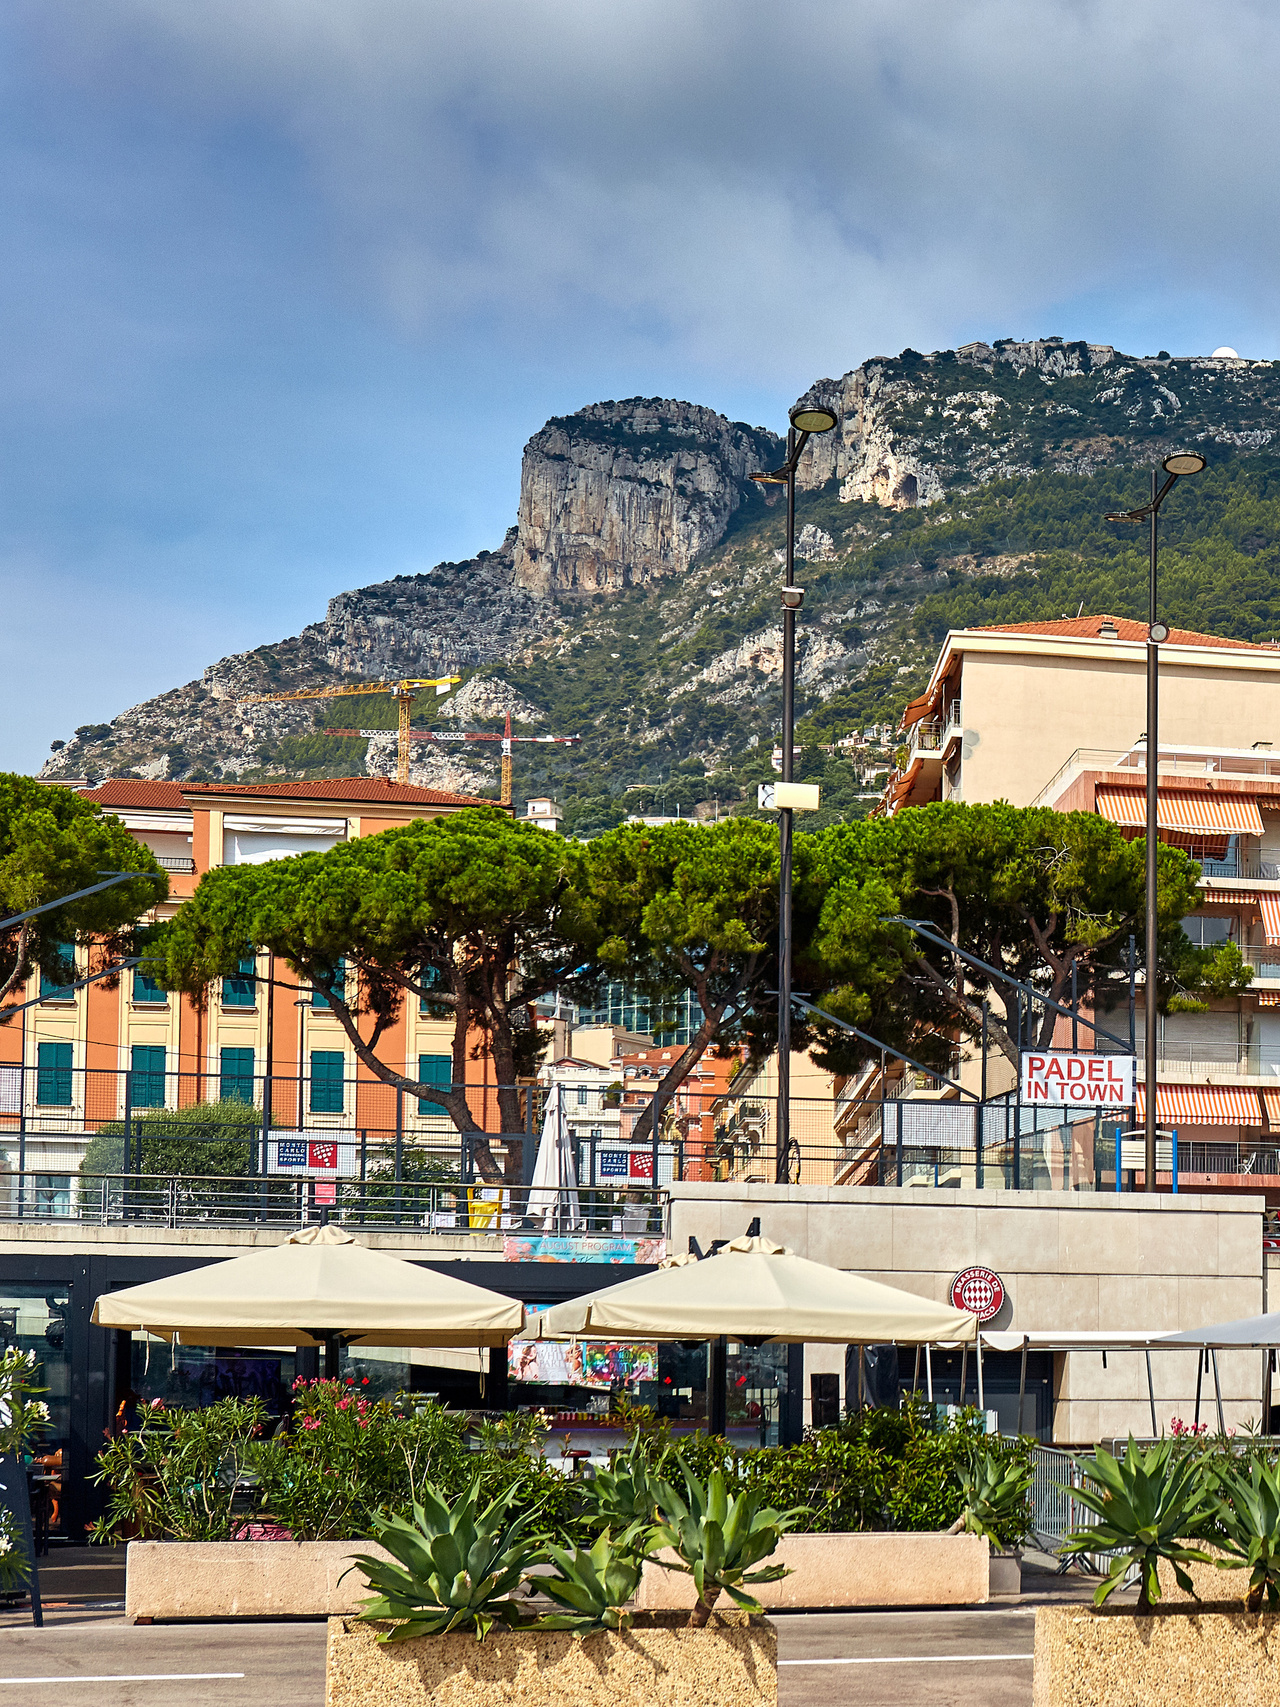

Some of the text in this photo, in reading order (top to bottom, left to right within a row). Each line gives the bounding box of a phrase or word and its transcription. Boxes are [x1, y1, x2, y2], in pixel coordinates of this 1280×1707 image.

[1028, 1057, 1123, 1082] PADEL
[1027, 1081, 1123, 1101] IN TOWN
[539, 1241, 631, 1251] AUGUST PROGRAM
[954, 1270, 1001, 1294] BRASSERIE DE
[609, 1361, 634, 1373] PARTY
